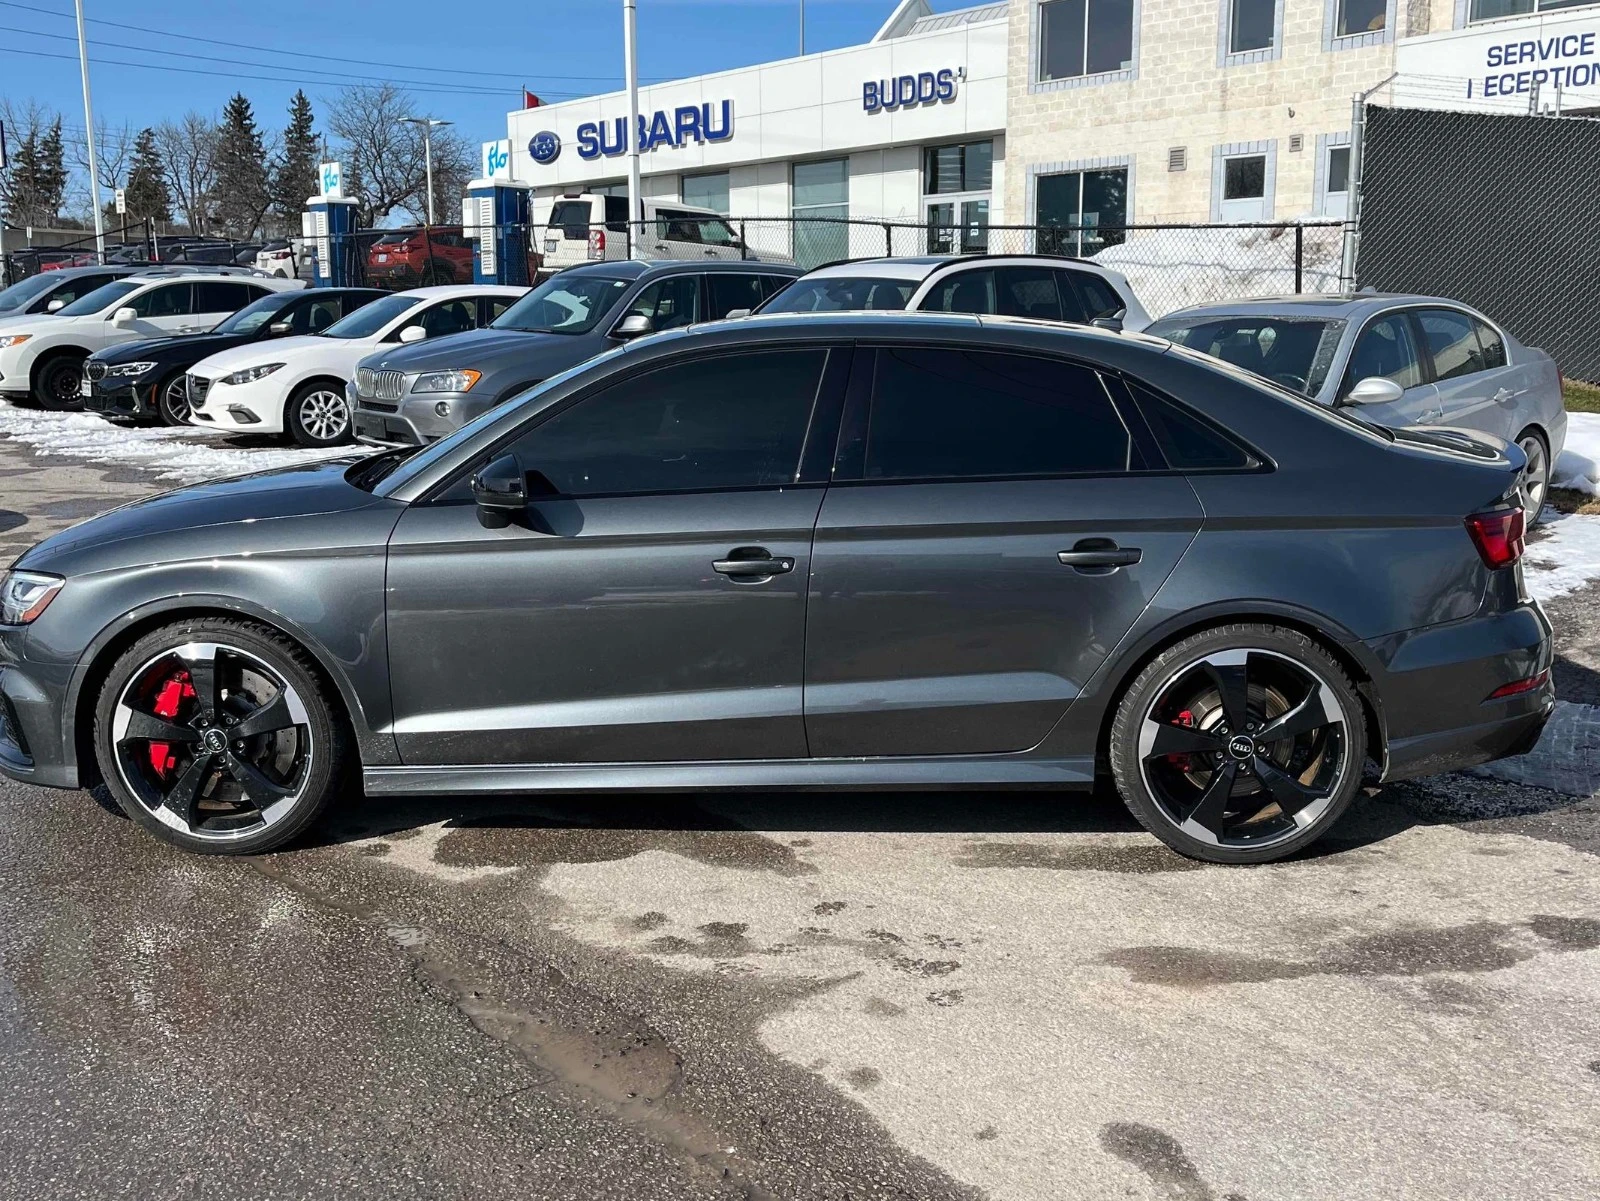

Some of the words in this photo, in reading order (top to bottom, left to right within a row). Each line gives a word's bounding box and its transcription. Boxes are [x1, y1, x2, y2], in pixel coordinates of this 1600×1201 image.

[1486, 32, 1596, 68] SERVICE
[1467, 63, 1600, 99] ECEPTION
[576, 99, 733, 160] SUBARU
[488, 139, 508, 177] flo
[323, 163, 339, 193] flo
